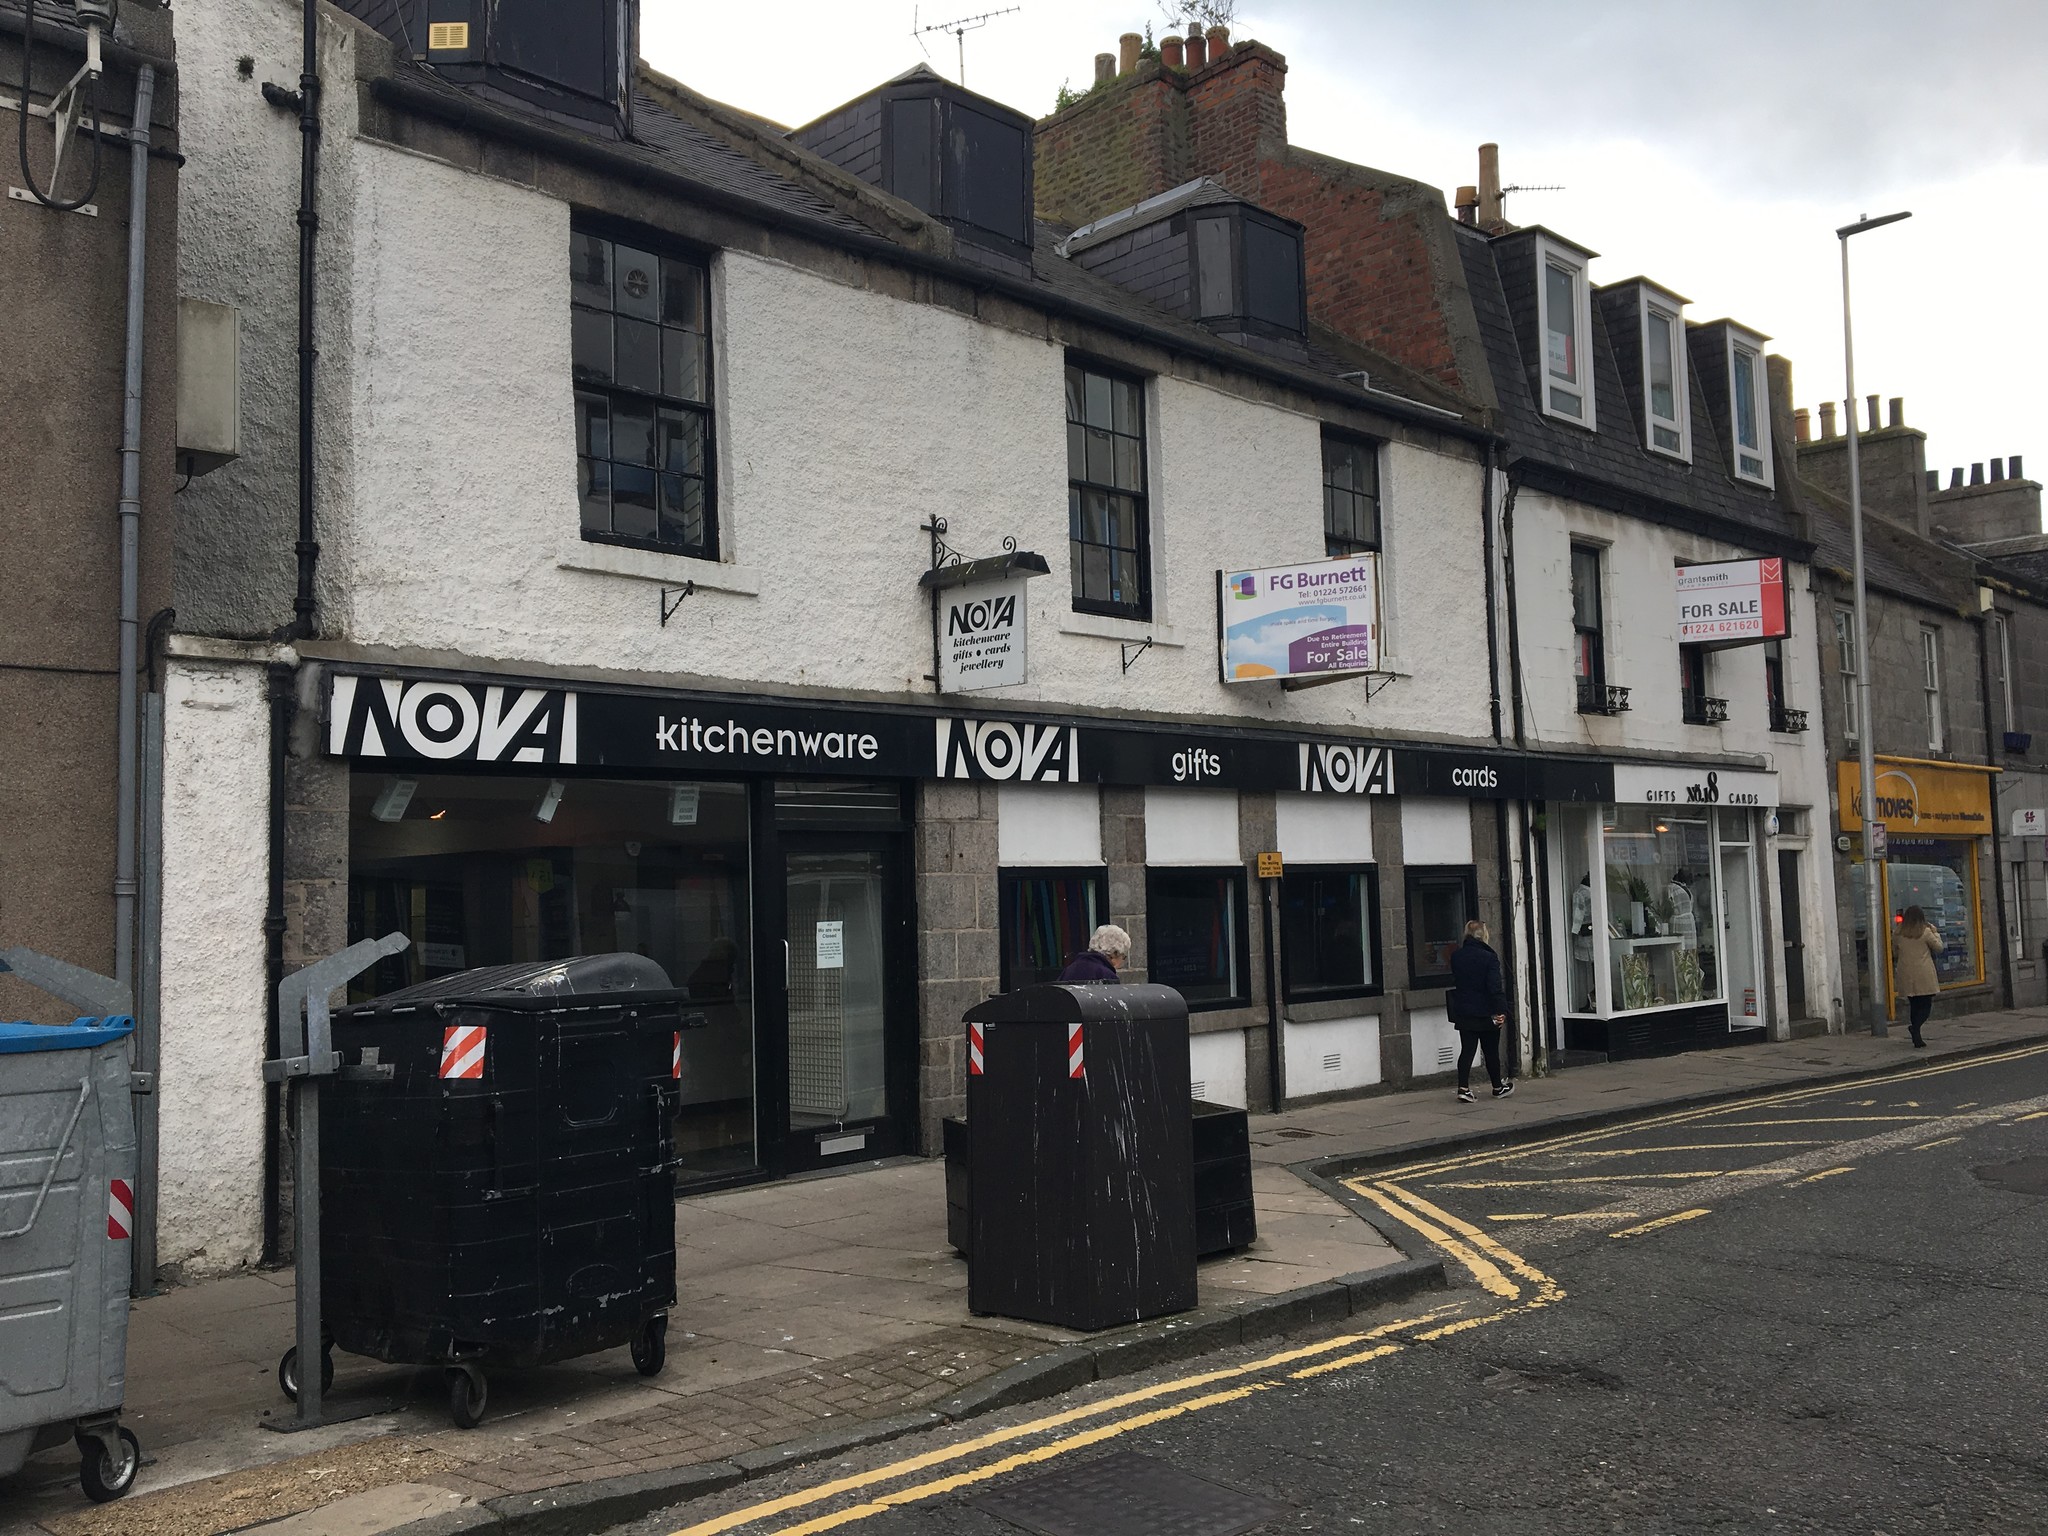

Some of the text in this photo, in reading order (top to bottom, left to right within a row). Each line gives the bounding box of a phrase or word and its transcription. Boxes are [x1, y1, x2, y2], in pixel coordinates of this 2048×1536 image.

[1270, 567, 1366, 591] FG Burnett
[1677, 573, 1729, 586] grantsmith
[1298, 584, 1367, 599] Tel: 01224 572661
[1298, 593, 1367, 605] www.fgburnett.co.uk
[948, 595, 1016, 637] NOVA
[1682, 600, 1758, 619] FOR SALE
[1307, 635, 1320, 643] Due
[1331, 631, 1367, 640] Retirement
[1682, 623, 1715, 636] 01224
[1719, 620, 1760, 632] 621620
[953, 631, 1011, 648] kitchenware
[1321, 638, 1367, 649] Entire Building
[952, 643, 1012, 662] gifts cards
[1307, 646, 1367, 664] For Sale
[959, 658, 1005, 674] jewellery
[1339, 660, 1367, 669] Enquiries
[330, 675, 578, 765] NOVA
[655, 715, 879, 760] kitchenware
[936, 717, 1080, 783] NOVA
[1172, 747, 1222, 782] gifts
[1299, 743, 1395, 795] NOVA
[1452, 765, 1498, 789] cards
[1646, 789, 1676, 802] GIFTS
[1729, 793, 1759, 805] CARDS
[1850, 786, 1914, 820] kemoves
